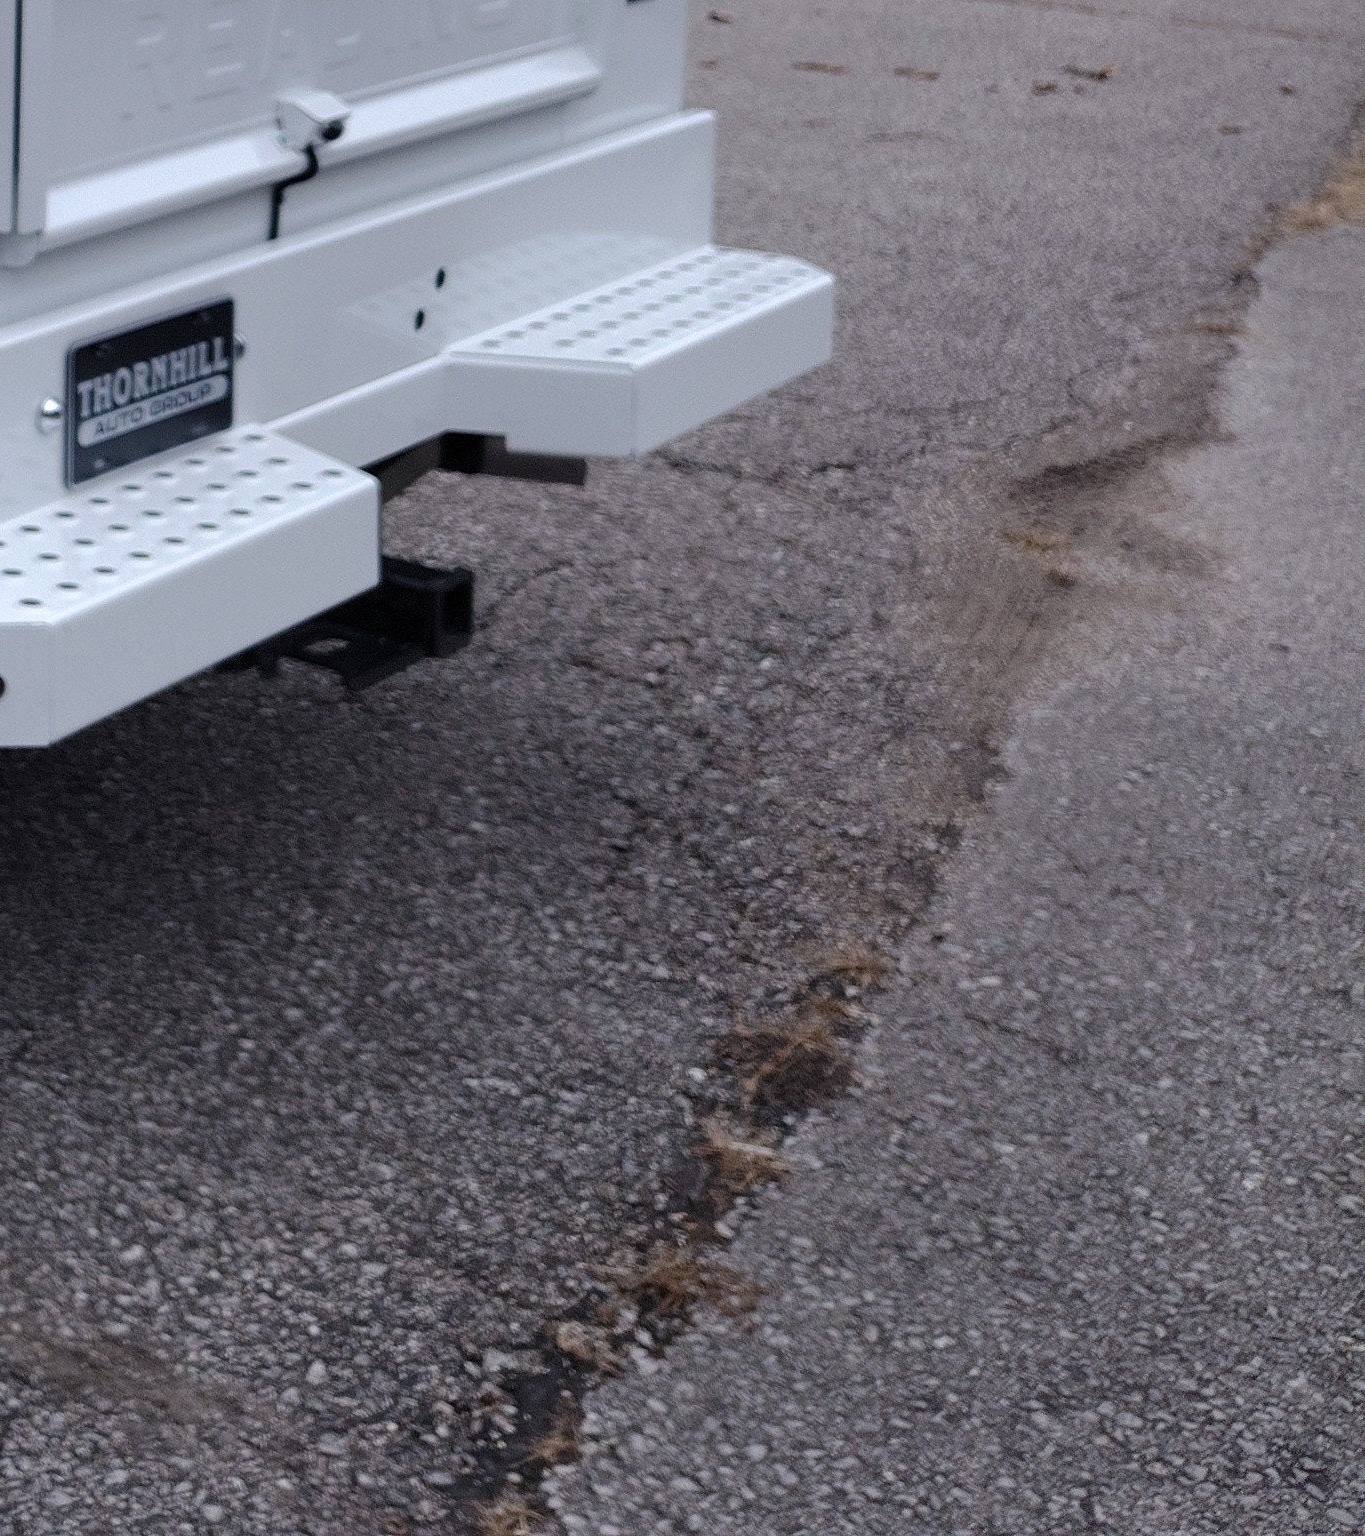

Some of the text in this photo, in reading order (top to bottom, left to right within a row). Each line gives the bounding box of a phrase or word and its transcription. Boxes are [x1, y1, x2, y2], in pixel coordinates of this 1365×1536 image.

[76, 336, 229, 417] THORNHILL
[94, 382, 212, 437] AUTO GROUP
